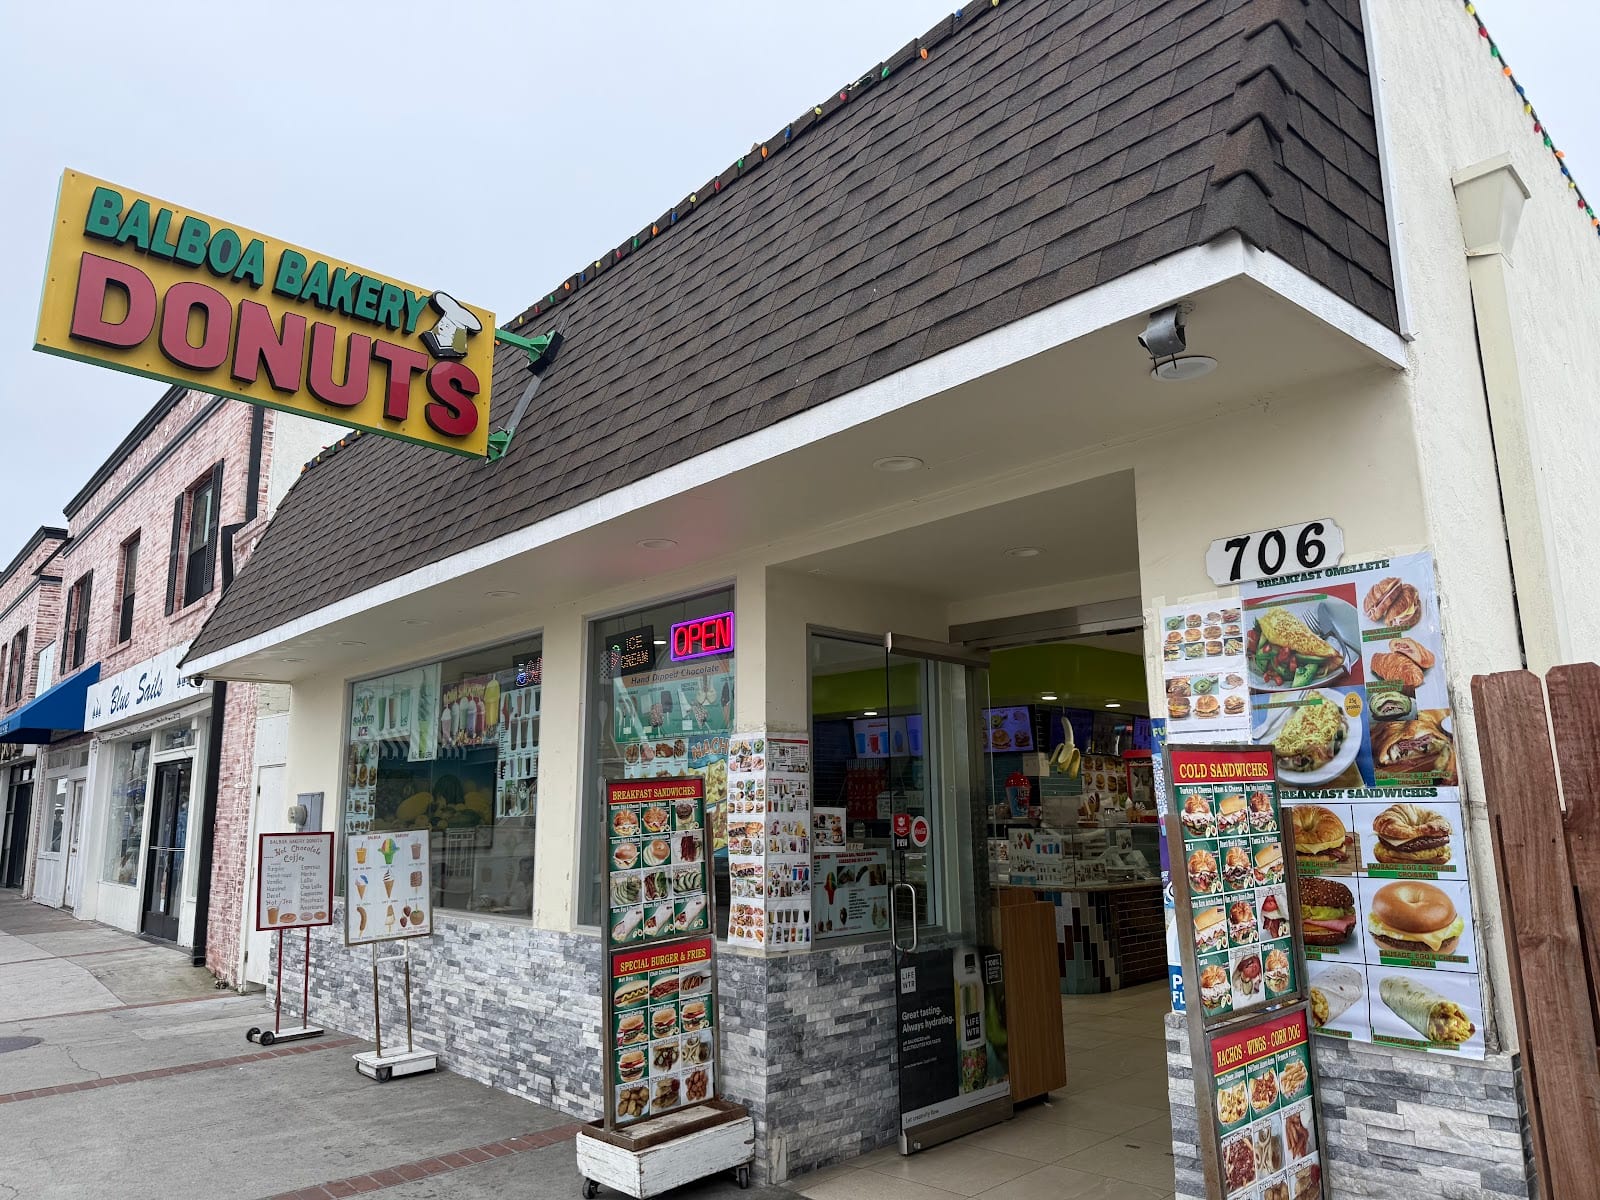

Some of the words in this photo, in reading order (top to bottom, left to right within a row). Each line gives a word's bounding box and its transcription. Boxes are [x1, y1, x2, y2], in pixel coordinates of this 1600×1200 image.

[84, 186, 265, 289] BALBOA
[272, 248, 429, 334] BAKERY
[69, 251, 481, 438] DONUTS
[1224, 522, 1326, 582] 706
[1256, 570, 1323, 589] BREAKFAST
[1325, 559, 1390, 577] OMELLETE
[674, 616, 730, 656] OPEN
[631, 674, 650, 685] Hand
[652, 670, 679, 682] Dipped
[680, 664, 720, 678] Chocolate
[110, 684, 131, 715] Blue
[136, 668, 164, 705] Sails
[1180, 763, 1208, 779] COLD
[1210, 763, 1268, 778] SANDWICHES
[612, 788, 653, 801] BREAKFAST
[653, 786, 696, 798] SANDWICHES
[1347, 787, 1438, 799] SANDWICHES
[620, 957, 649, 972] SPECIAL
[651, 953, 679, 967] BURGER
[680, 952, 685, 960] &
[687, 948, 706, 960] FRIES
[902, 970, 915, 981] LIFE
[902, 980, 915, 989] WTR
[901, 1008, 920, 1021] Great
[920, 1005, 942, 1017] tasting.
[966, 1016, 979, 1027] LIFE
[902, 1021, 925, 1034] Always
[925, 1014, 954, 1029] hydrating.
[1216, 1044, 1243, 1068] NACHOS
[1247, 1035, 1267, 1056] WINGS
[1270, 1027, 1287, 1047] CORN
[1288, 1023, 1301, 1041] DOG
